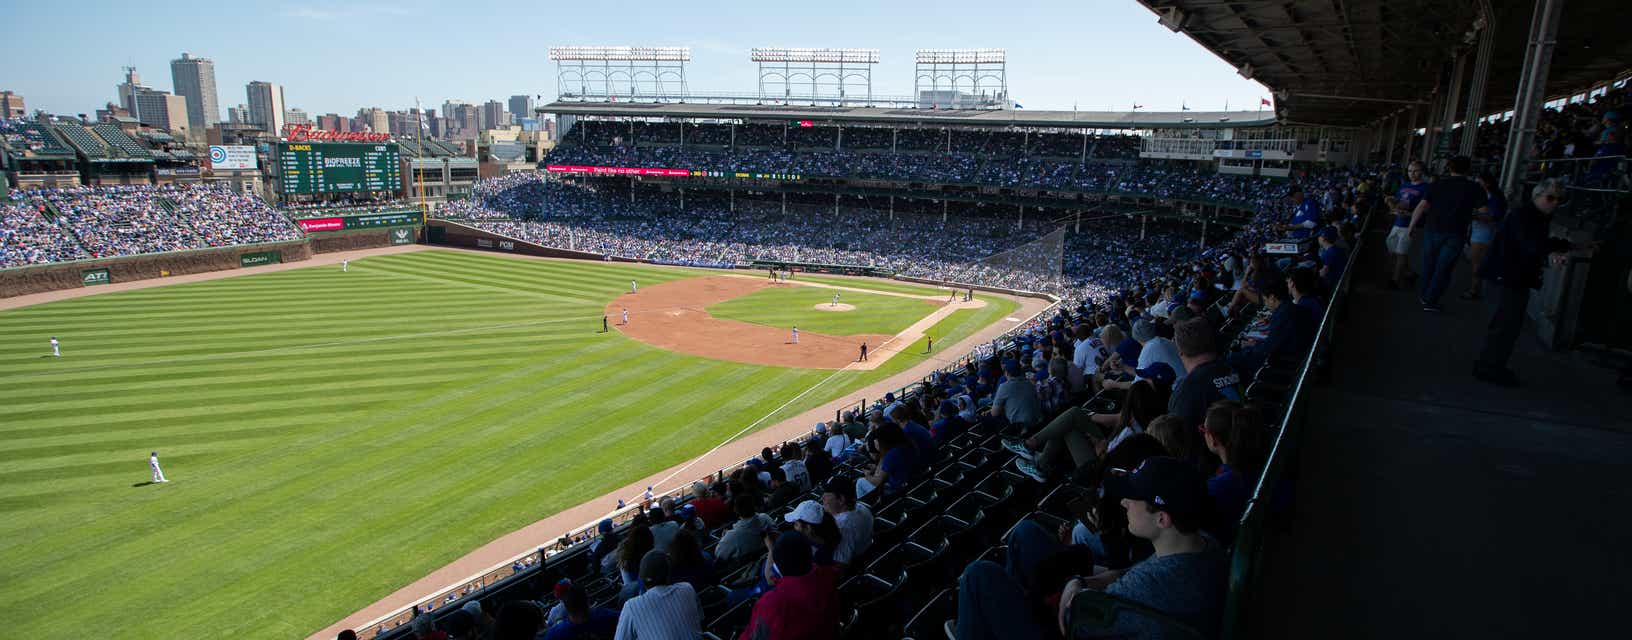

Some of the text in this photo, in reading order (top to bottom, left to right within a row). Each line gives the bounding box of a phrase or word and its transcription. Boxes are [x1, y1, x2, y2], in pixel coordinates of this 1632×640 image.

[284, 122, 389, 141] Budweiser
[242, 256, 268, 264] SLOAN
[84, 271, 107, 281] ATI
